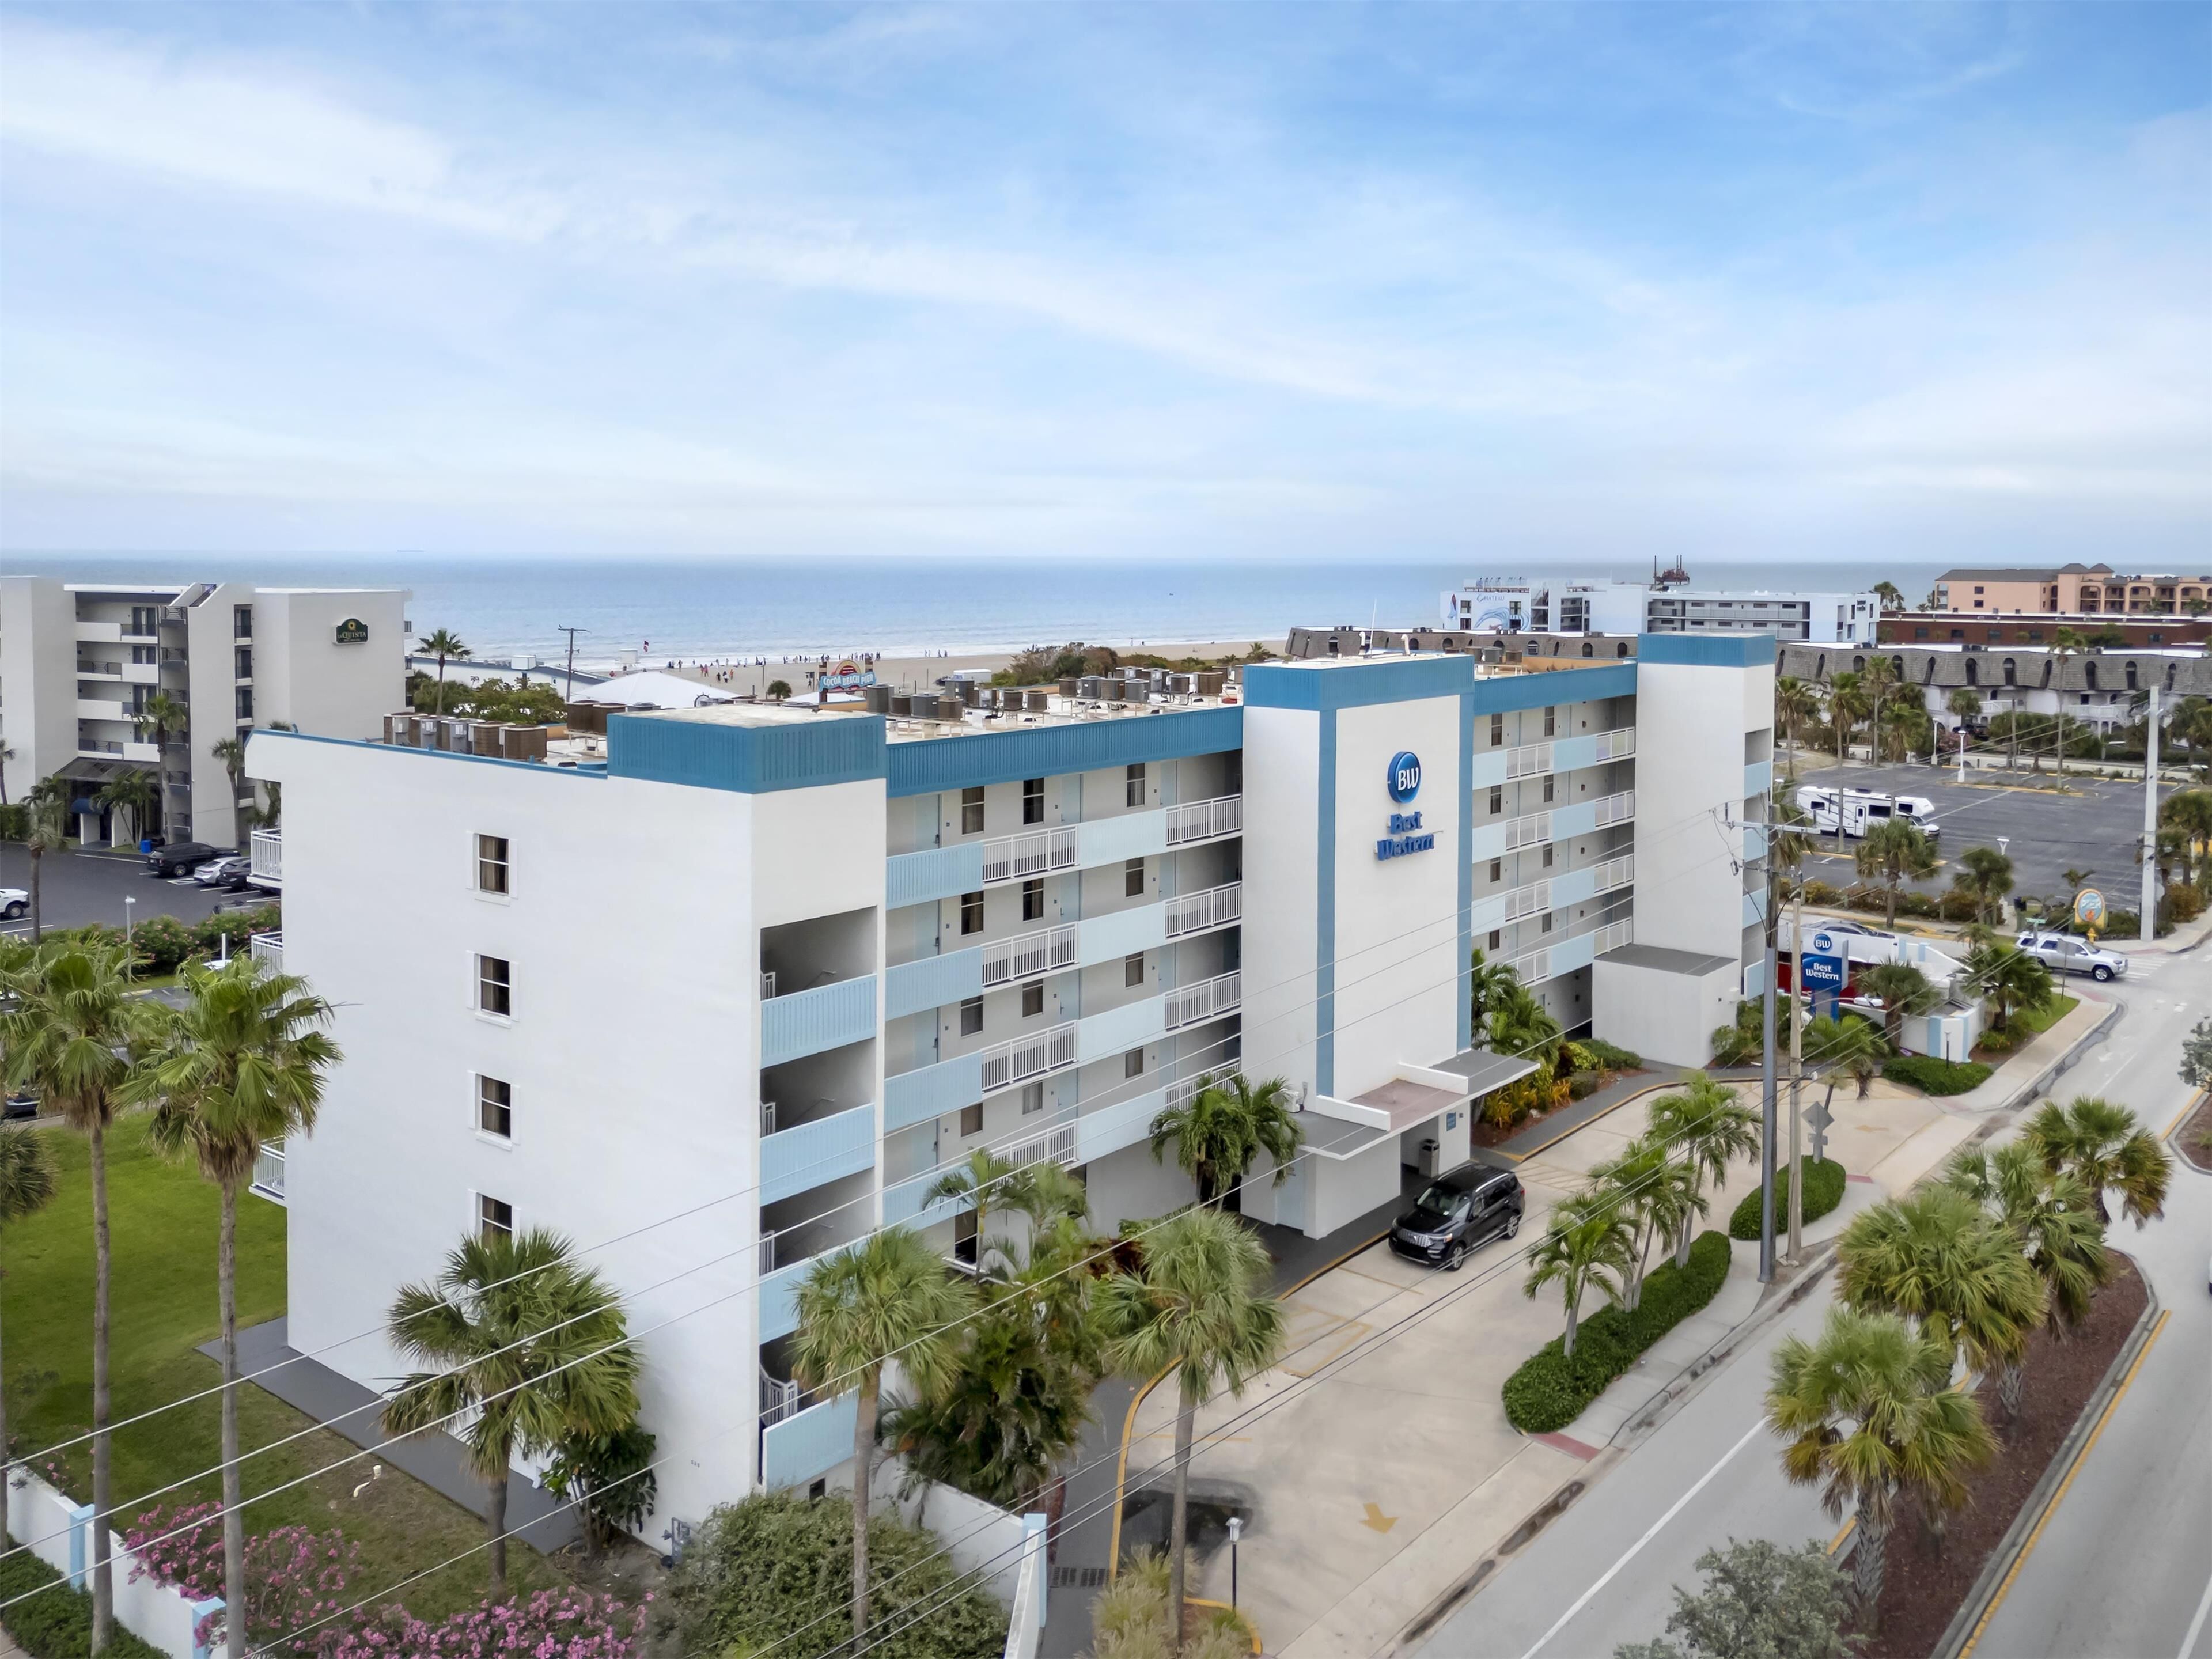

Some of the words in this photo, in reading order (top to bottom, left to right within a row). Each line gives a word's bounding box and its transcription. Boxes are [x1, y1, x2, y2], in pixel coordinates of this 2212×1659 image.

[342, 631, 366, 639] QUINTA
[823, 676, 842, 686] COCOA
[842, 675, 860, 685] BEACH
[861, 673, 874, 684] PIER
[1397, 767, 1419, 791] BW
[1390, 811, 1423, 834] Best
[1377, 834, 1435, 861] Western
[1816, 939, 1831, 949] BW
[1813, 963, 1832, 972] Best
[1805, 969, 1839, 980] Western
